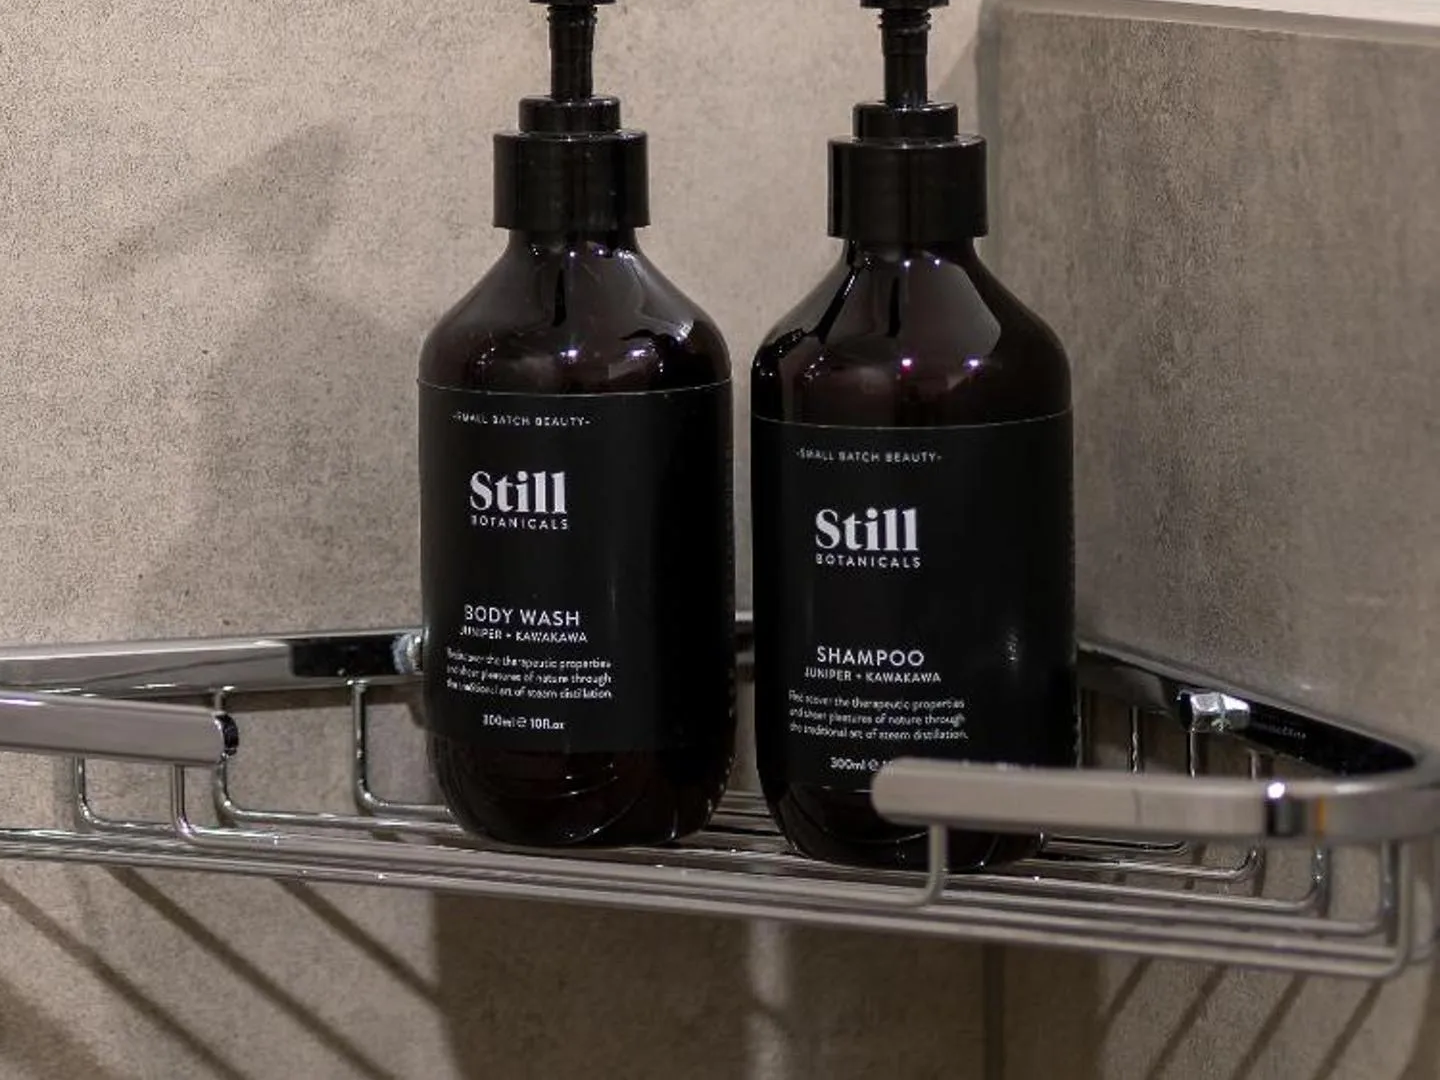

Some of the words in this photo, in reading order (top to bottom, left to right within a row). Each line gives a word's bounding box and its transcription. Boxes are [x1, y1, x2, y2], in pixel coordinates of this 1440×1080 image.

[839, 451, 880, 462] BATCH
[470, 471, 567, 514] Still
[471, 515, 568, 530] BOTANICALS
[815, 507, 919, 551] Still
[815, 553, 921, 569] BOTANICALS
[464, 604, 514, 624] BODY
[519, 609, 580, 626] WASH
[460, 625, 502, 640] JUNIPER
[516, 631, 588, 643] KAWAKAWA
[816, 645, 925, 667] SHAMPOO
[571, 672, 612, 687] through
[805, 667, 852, 682] JUNIPER
[865, 672, 942, 684] KAWAKAWA
[875, 713, 887, 724] of
[865, 728, 878, 740] of
[830, 757, 866, 771] 300ml
